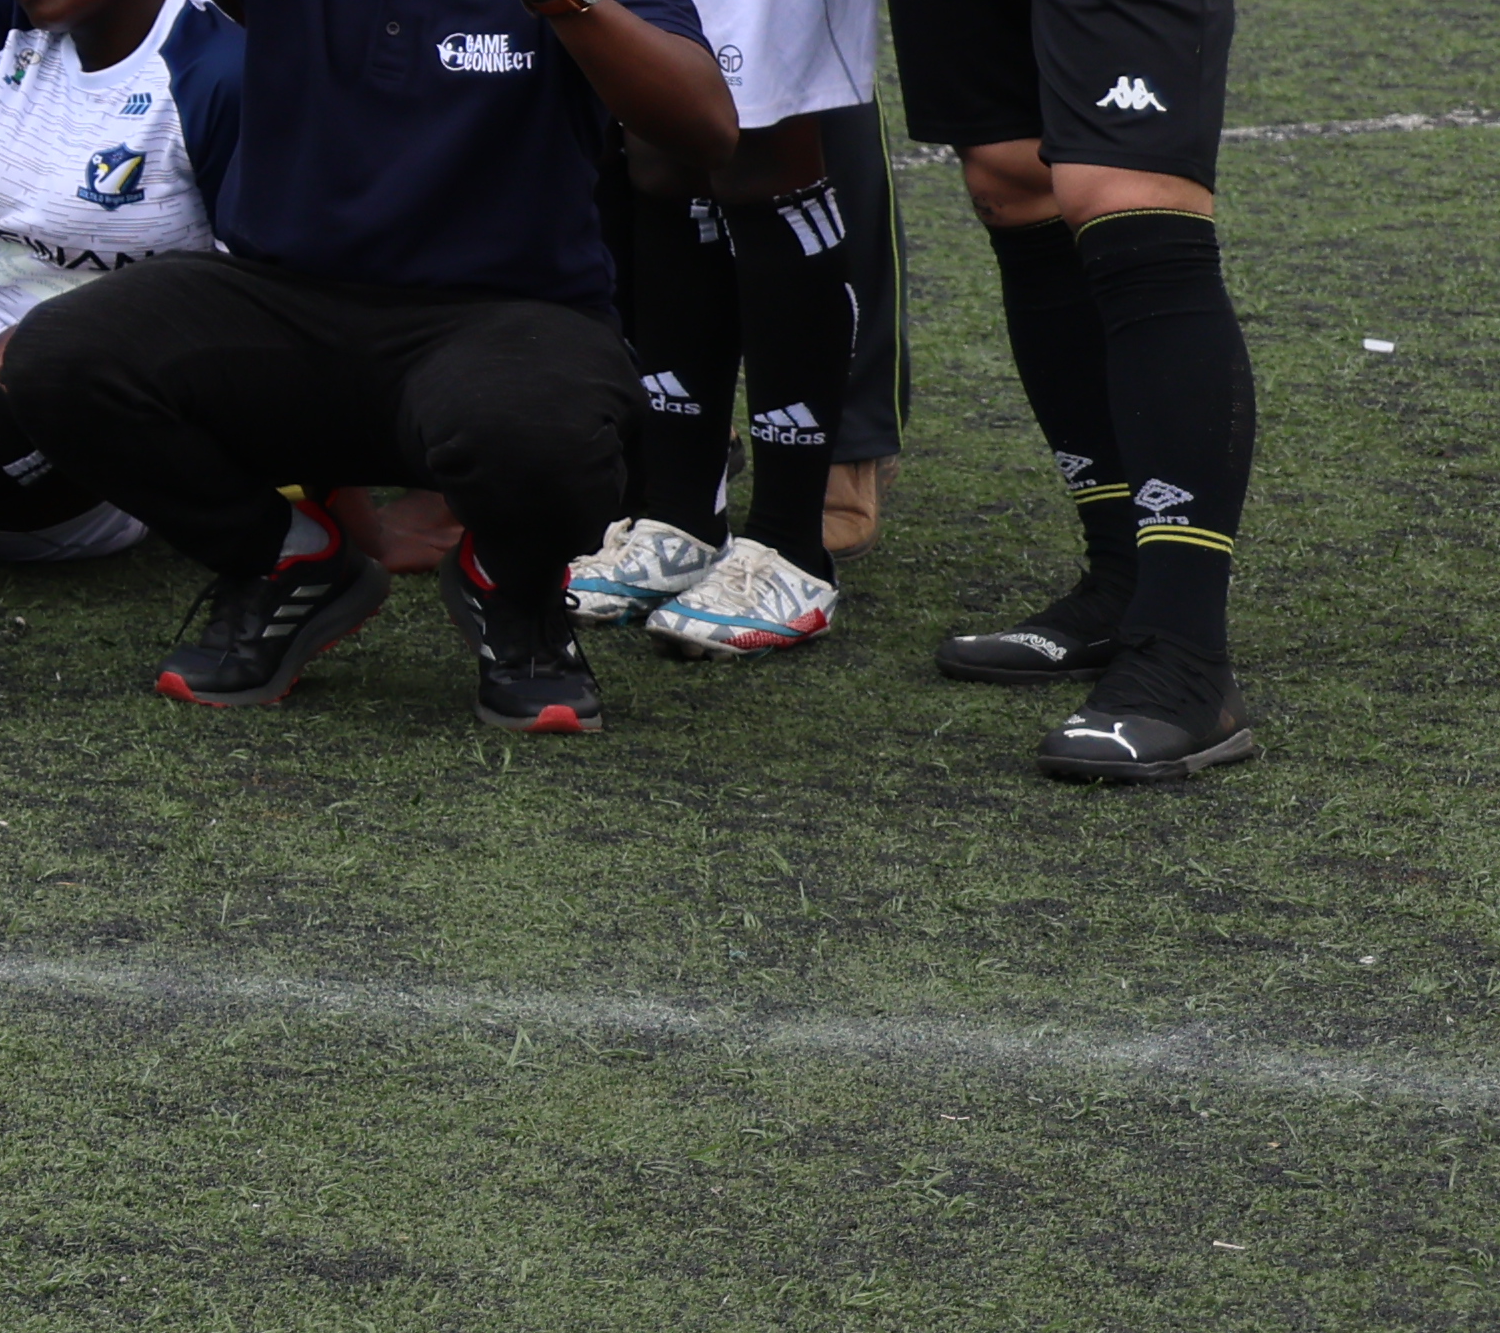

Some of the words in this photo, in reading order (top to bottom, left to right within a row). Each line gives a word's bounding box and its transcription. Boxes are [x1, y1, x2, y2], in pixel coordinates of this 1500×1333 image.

[465, 33, 509, 54] GAME
[463, 51, 536, 73] CONNECT
[649, 393, 701, 415] das
[750, 422, 827, 446] adidas
